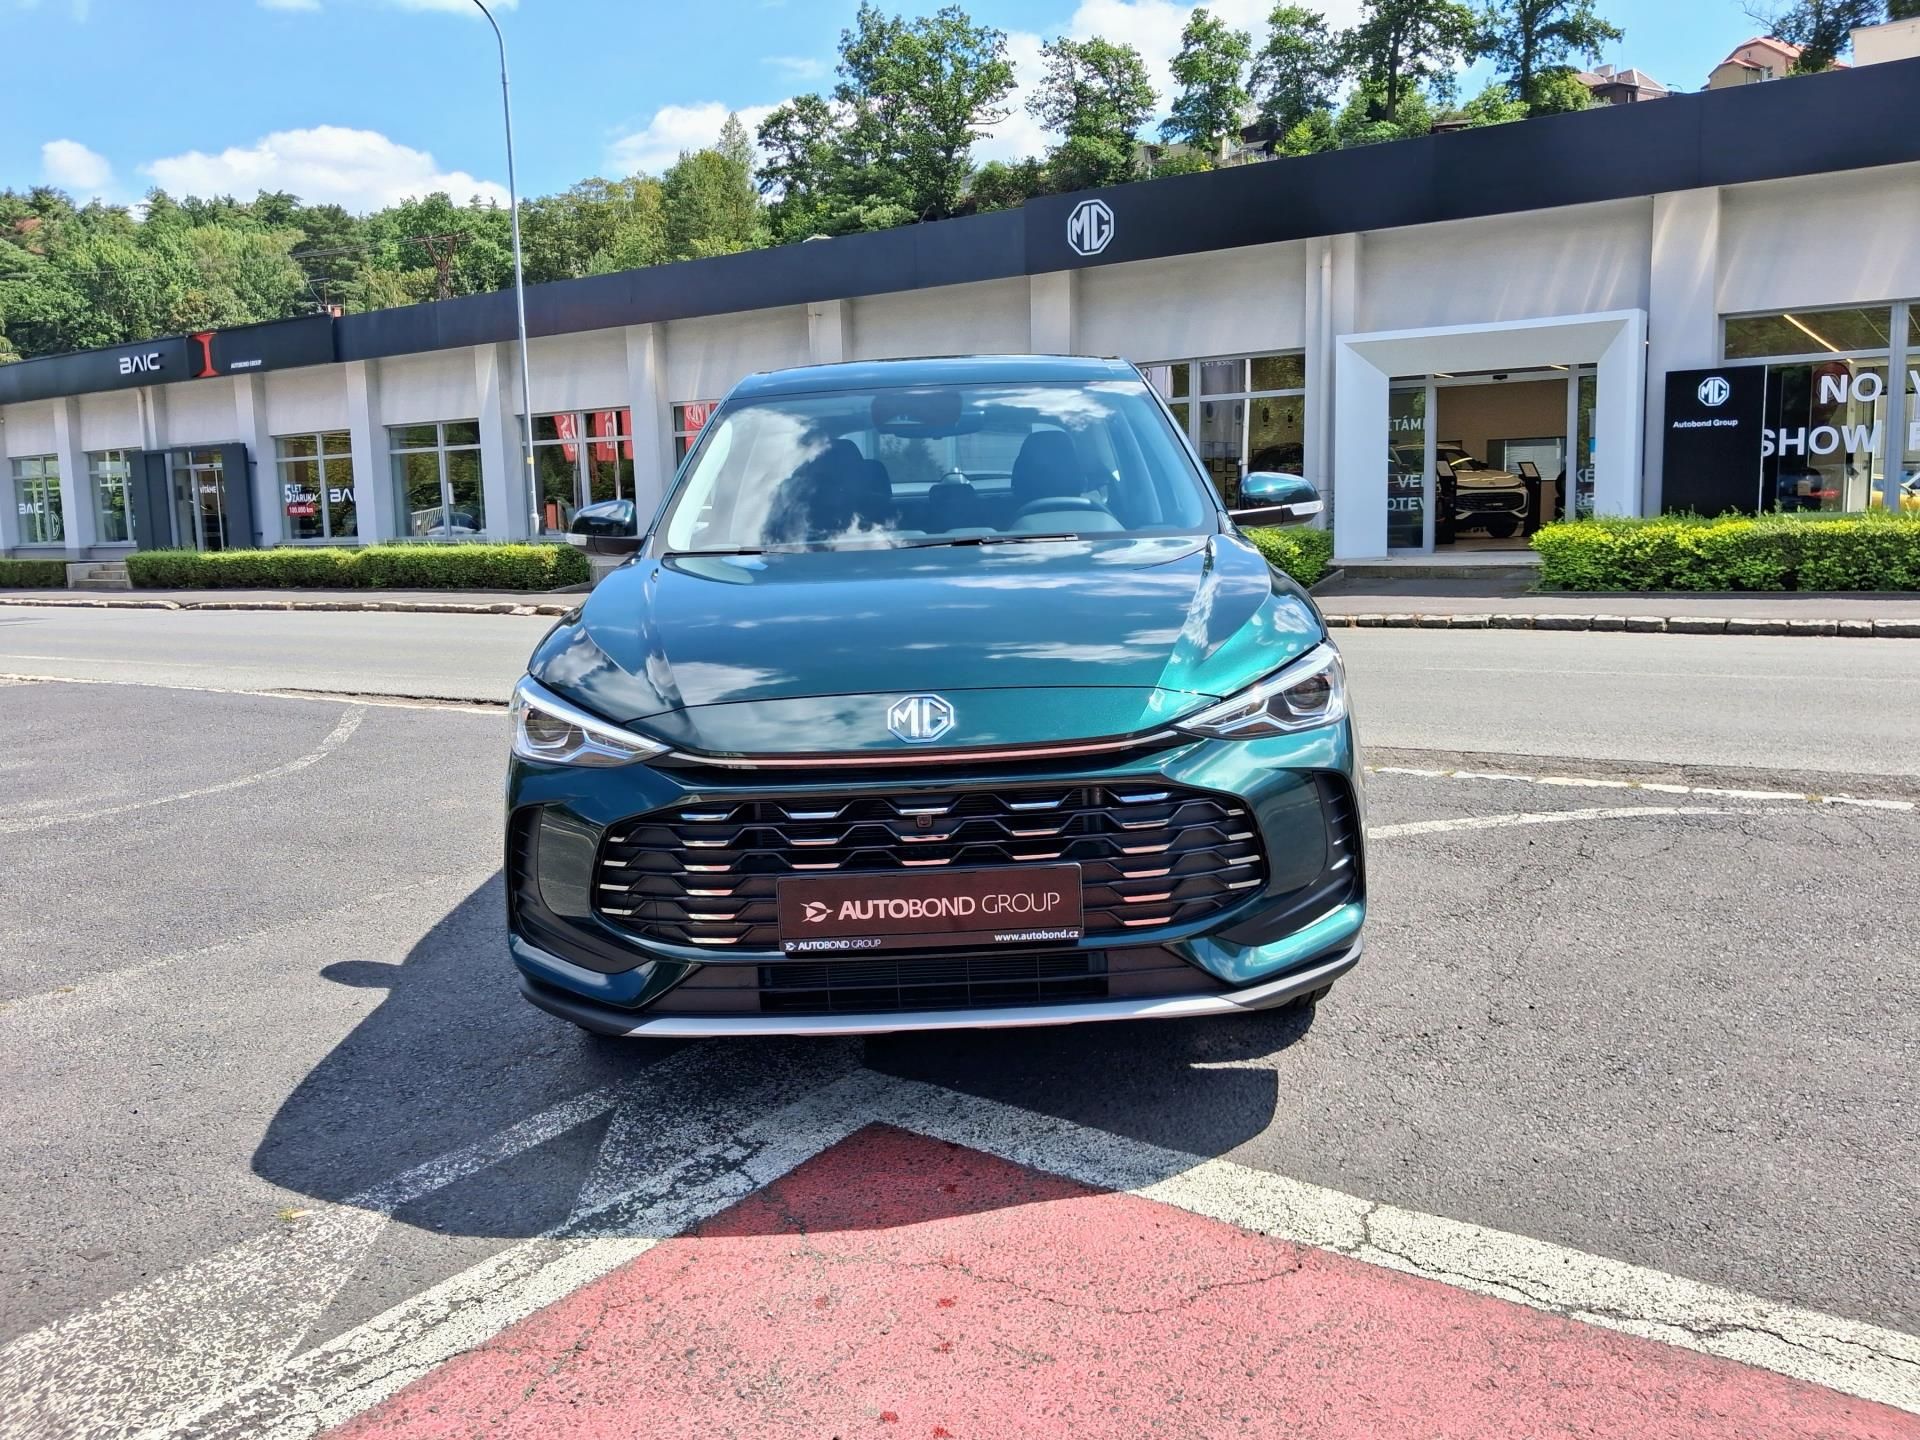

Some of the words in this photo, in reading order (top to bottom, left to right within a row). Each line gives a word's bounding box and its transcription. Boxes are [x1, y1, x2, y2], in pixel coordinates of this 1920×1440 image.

[1071, 204, 1110, 251] MG
[119, 353, 160, 375] BAIC
[1701, 379, 1728, 404] MG
[1673, 420, 1712, 428] Autobond
[1713, 419, 1738, 427] Group
[1762, 425, 1882, 458] SHOW
[892, 697, 949, 738] MG
[838, 896, 976, 920] AUTOBOND
[981, 892, 1061, 914] GROUP
[798, 940, 850, 951] AUTOBOND
[851, 938, 882, 949] GROUP
[994, 929, 1079, 942] www.autobond.cz
